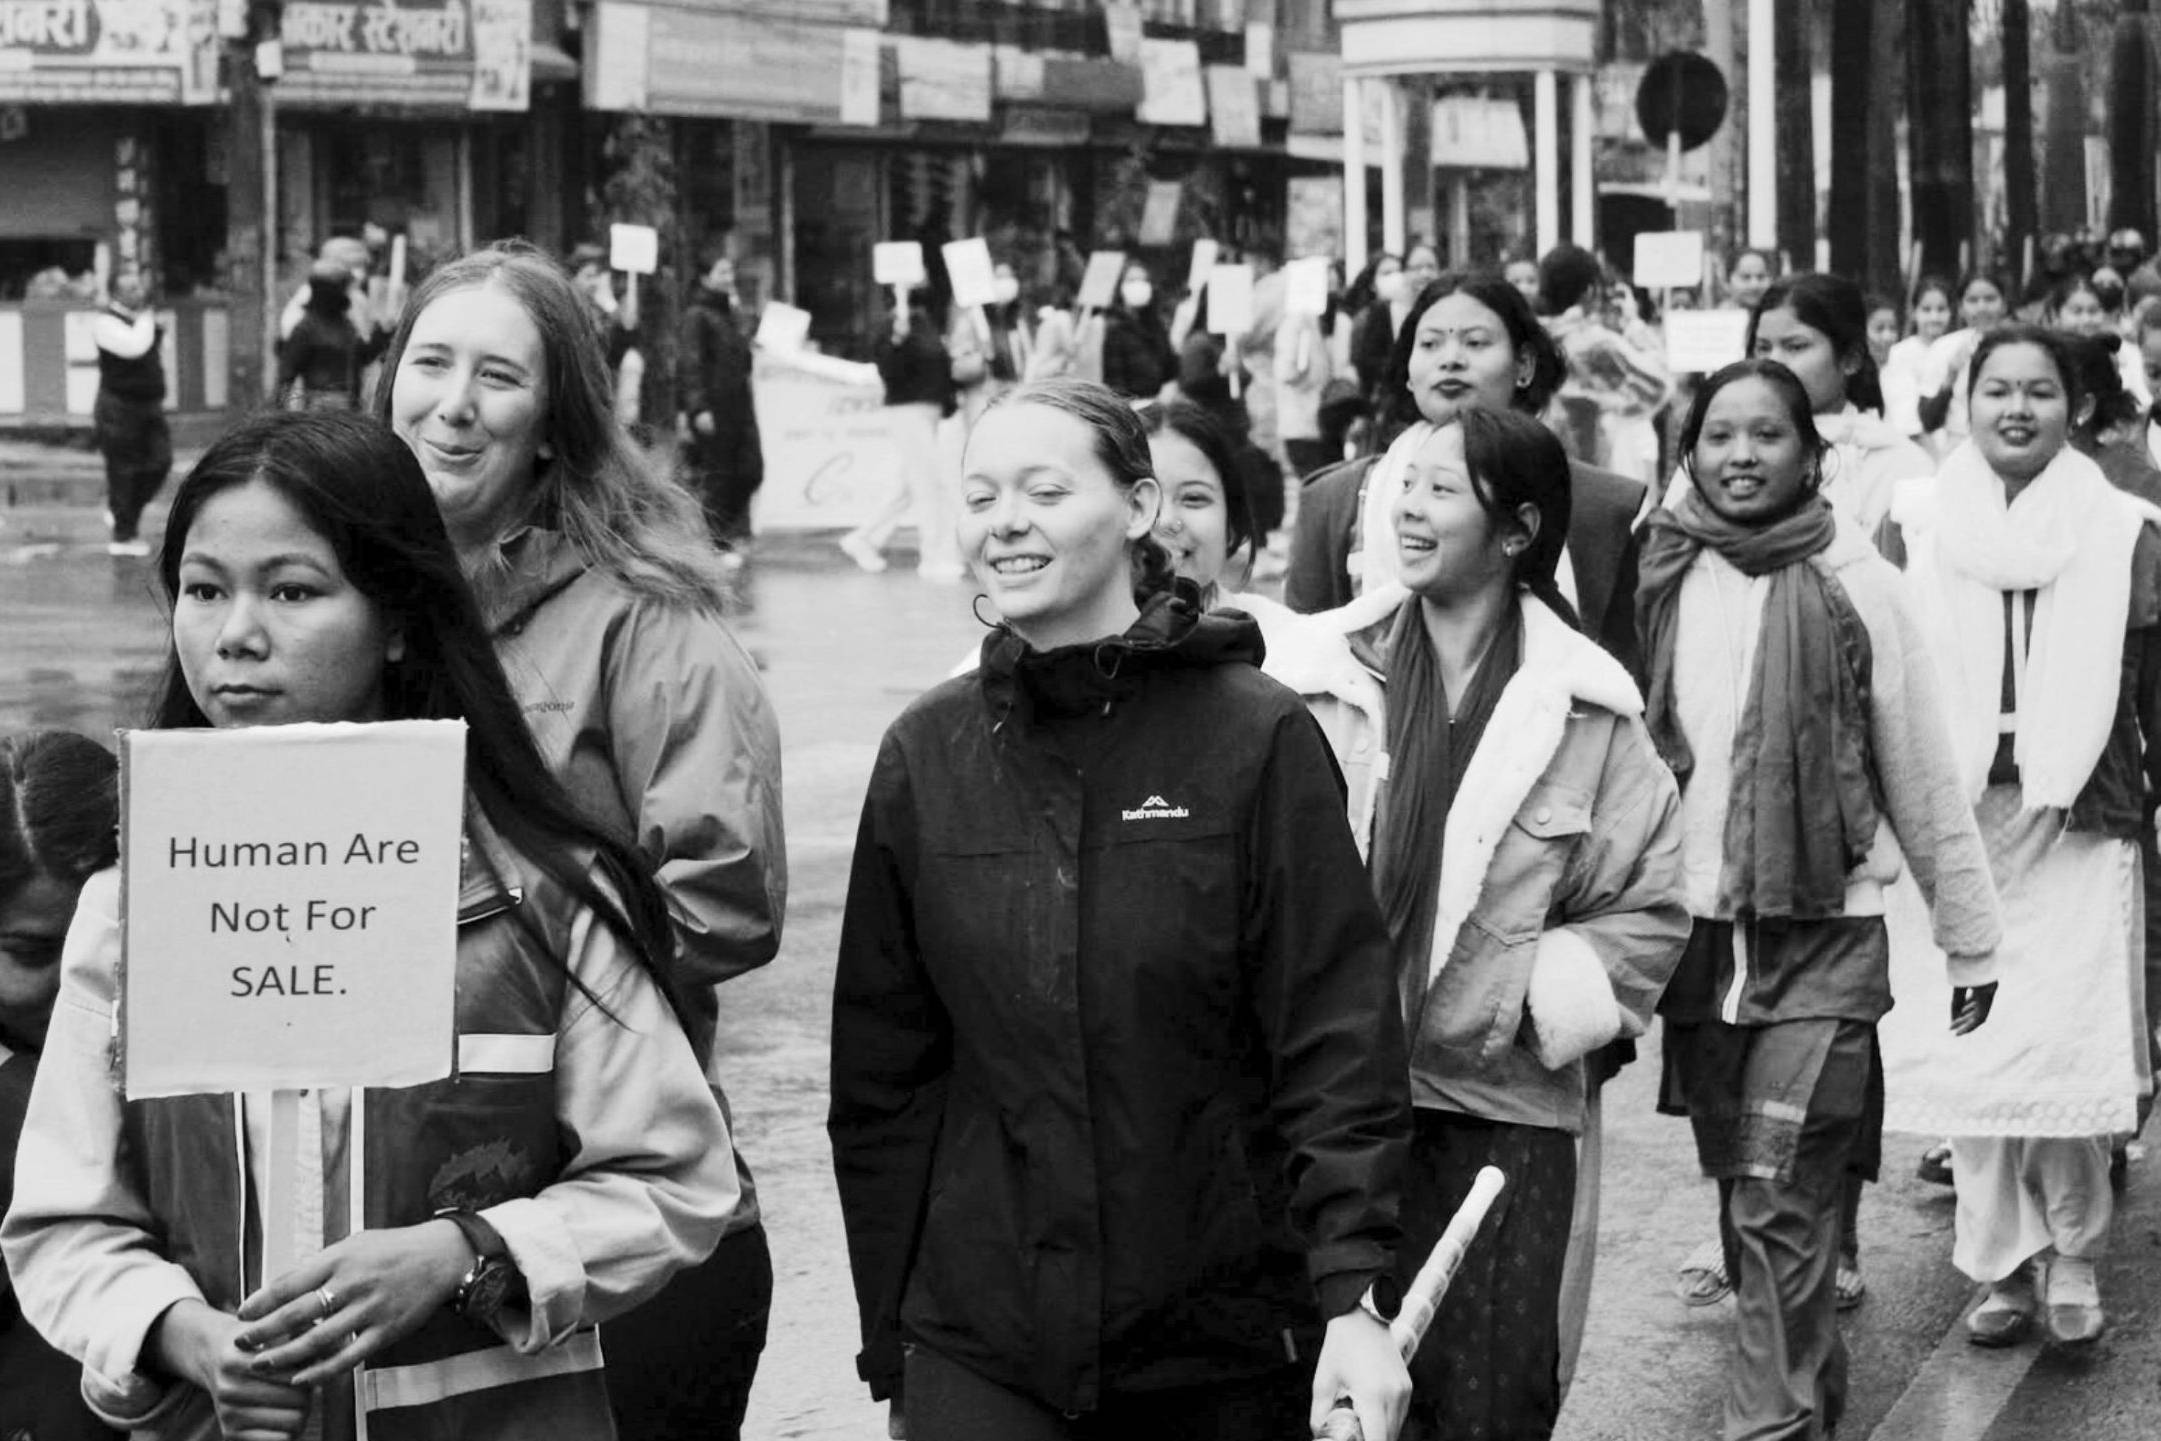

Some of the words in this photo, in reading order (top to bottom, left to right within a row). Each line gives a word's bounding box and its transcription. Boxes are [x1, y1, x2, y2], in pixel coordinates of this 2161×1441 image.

[169, 836, 328, 868] Human
[343, 833, 420, 865] Are
[210, 902, 290, 933] Not
[306, 900, 377, 931] For
[231, 964, 348, 997] SALE.
